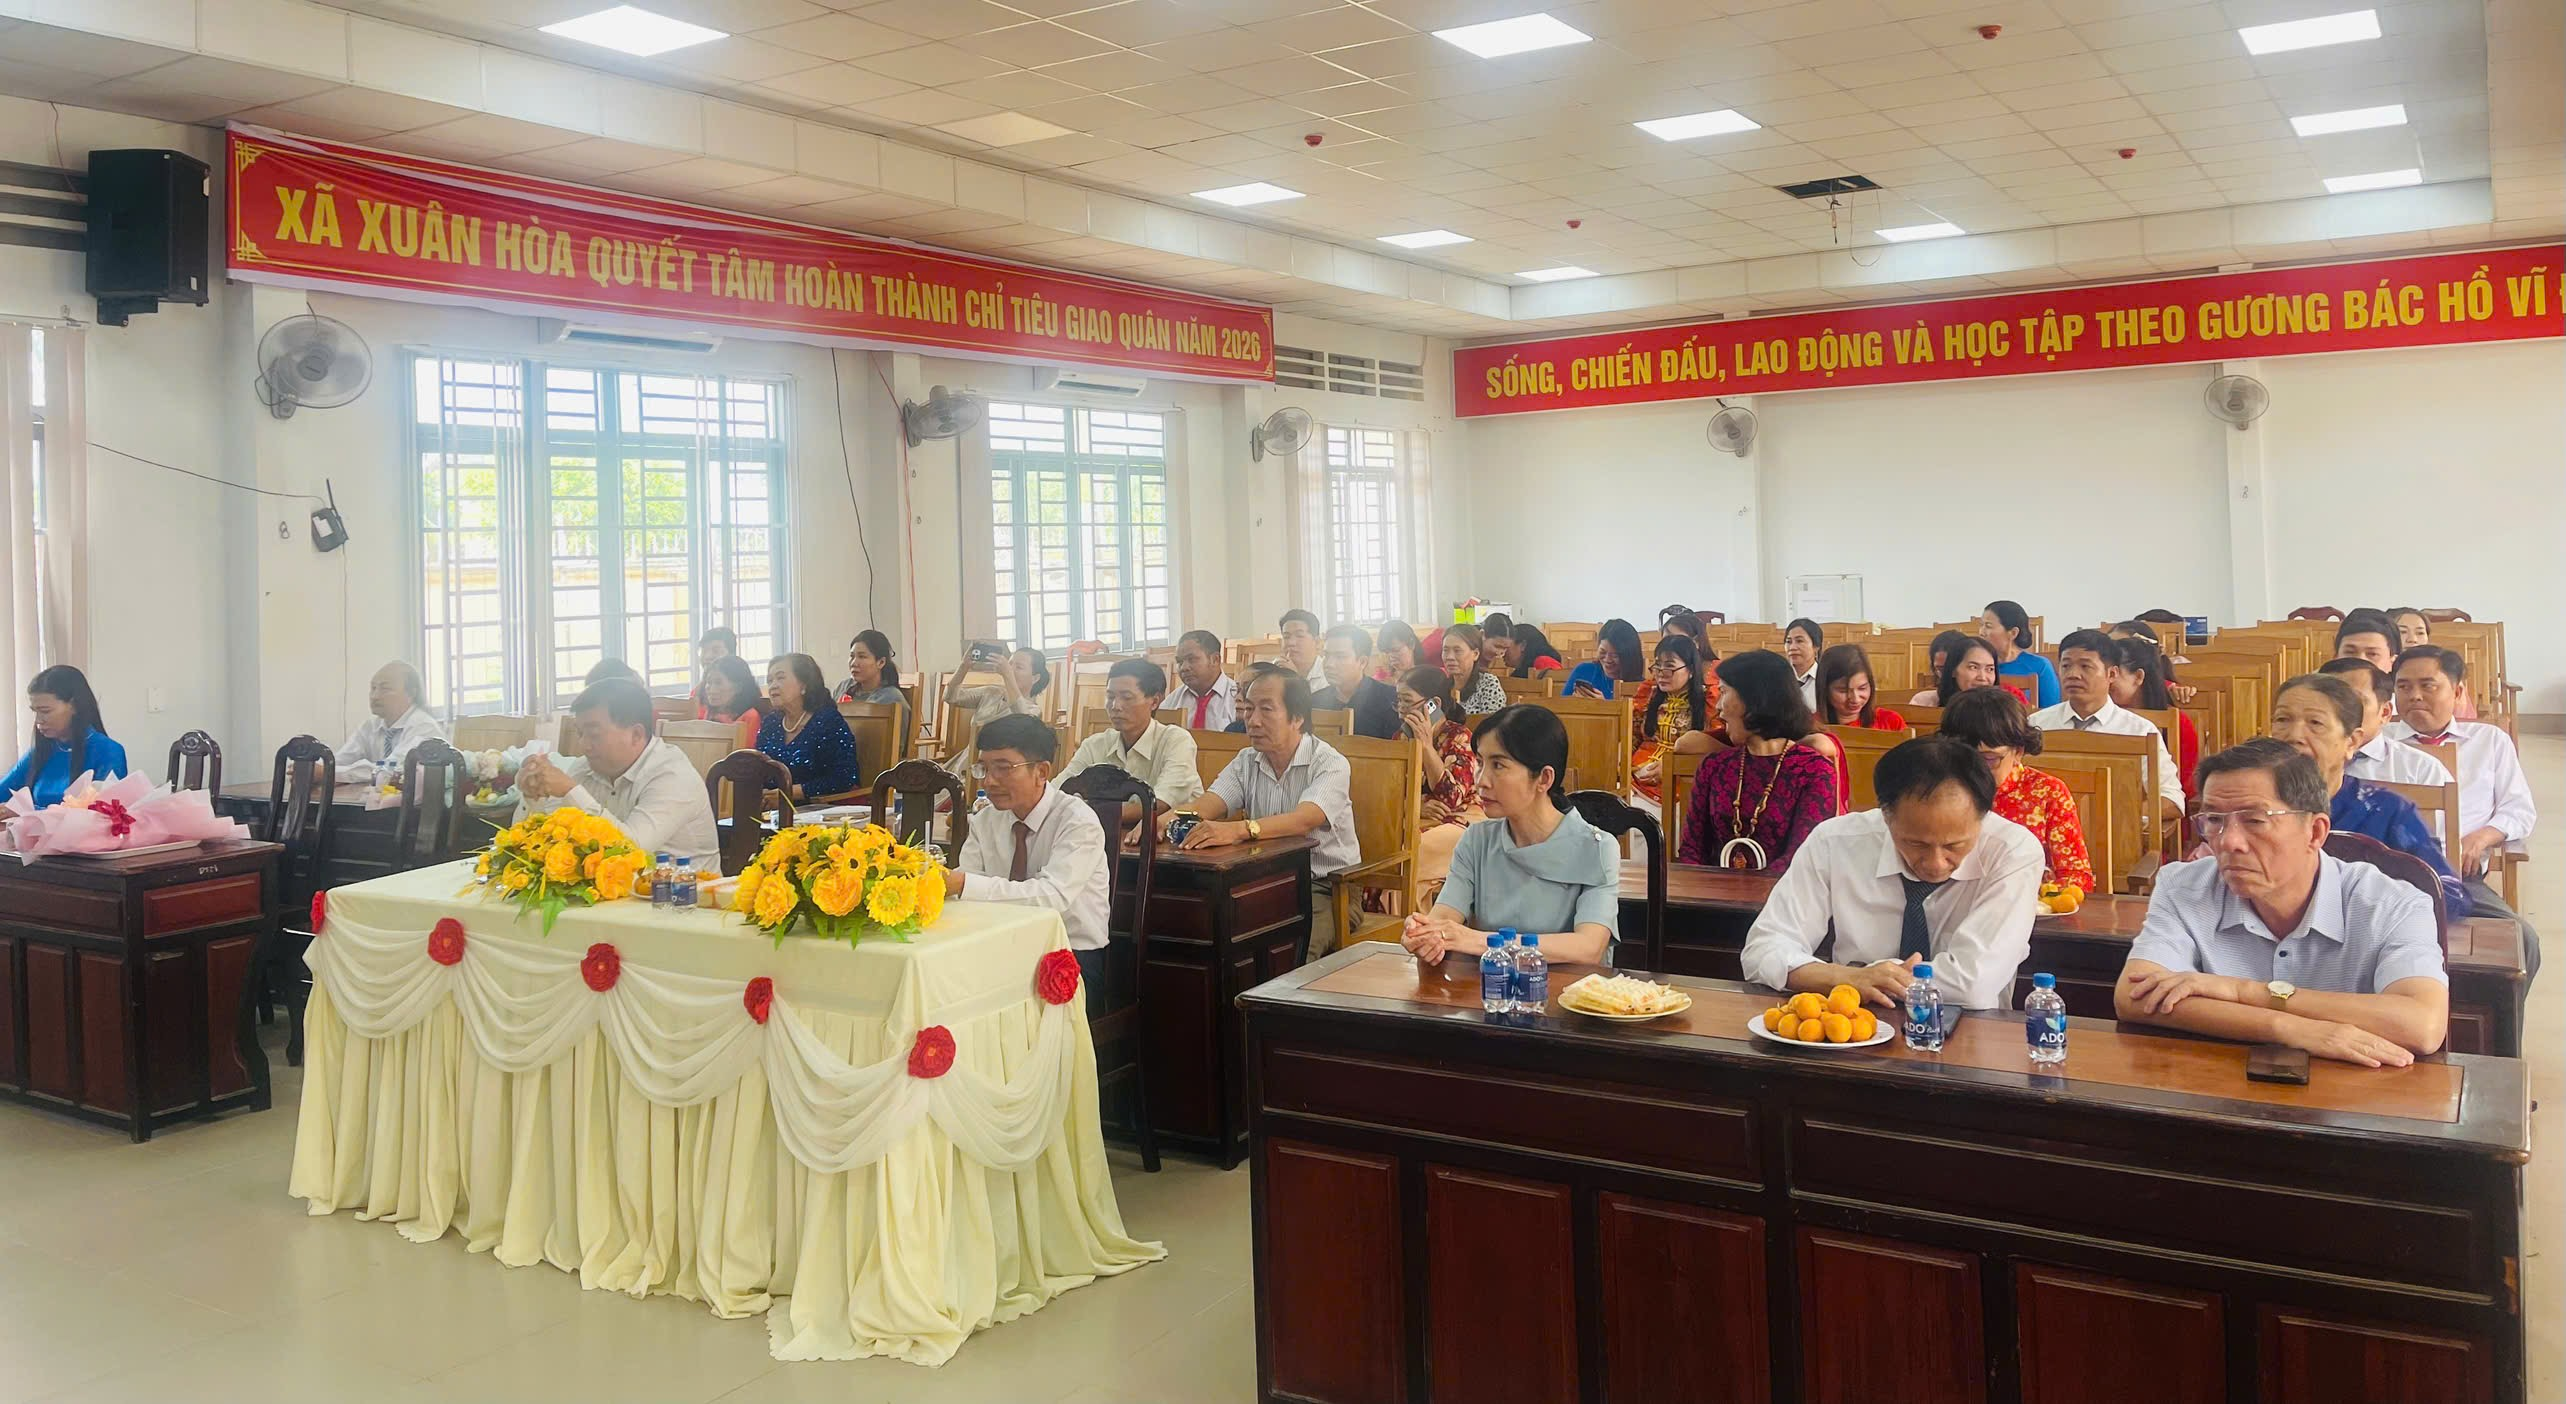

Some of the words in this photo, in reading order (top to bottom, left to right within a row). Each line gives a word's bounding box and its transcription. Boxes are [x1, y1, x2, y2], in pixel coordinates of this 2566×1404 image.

[276, 184, 342, 247] XÃ
[359, 200, 481, 265] XUÂN
[496, 217, 575, 277] HÒA
[588, 234, 697, 292] QUYẾT
[709, 249, 774, 302] TÂM
[785, 261, 863, 312] HOÀN
[872, 274, 957, 324] THÀNH
[966, 283, 1004, 329] CHỈ
[1011, 294, 1058, 336] TIÊU
[1066, 306, 1112, 344] GIAO
[1119, 309, 1170, 351] QUÂN
[1176, 318, 1216, 356] NĂM
[1222, 328, 1261, 361] 2026
[1487, 352, 1562, 398] SỐNG,
[1572, 343, 1651, 390] CHIẾN
[1660, 336, 1725, 382] ĐẤU,
[1736, 340, 1788, 376] LAO
[1798, 329, 1882, 377] ĐỘNG
[1893, 321, 1934, 364] VÀ
[1945, 321, 2009, 366] HỌC
[2020, 309, 2084, 361] TẬP
[2096, 306, 2185, 348] THEO
[2199, 293, 2329, 340] GƯƠNG
[2344, 280, 2424, 329] BÁC
[2439, 265, 2493, 322] HỒ
[2507, 267, 2546, 317] VĨ
[2040, 1032, 2065, 1043] ADO
